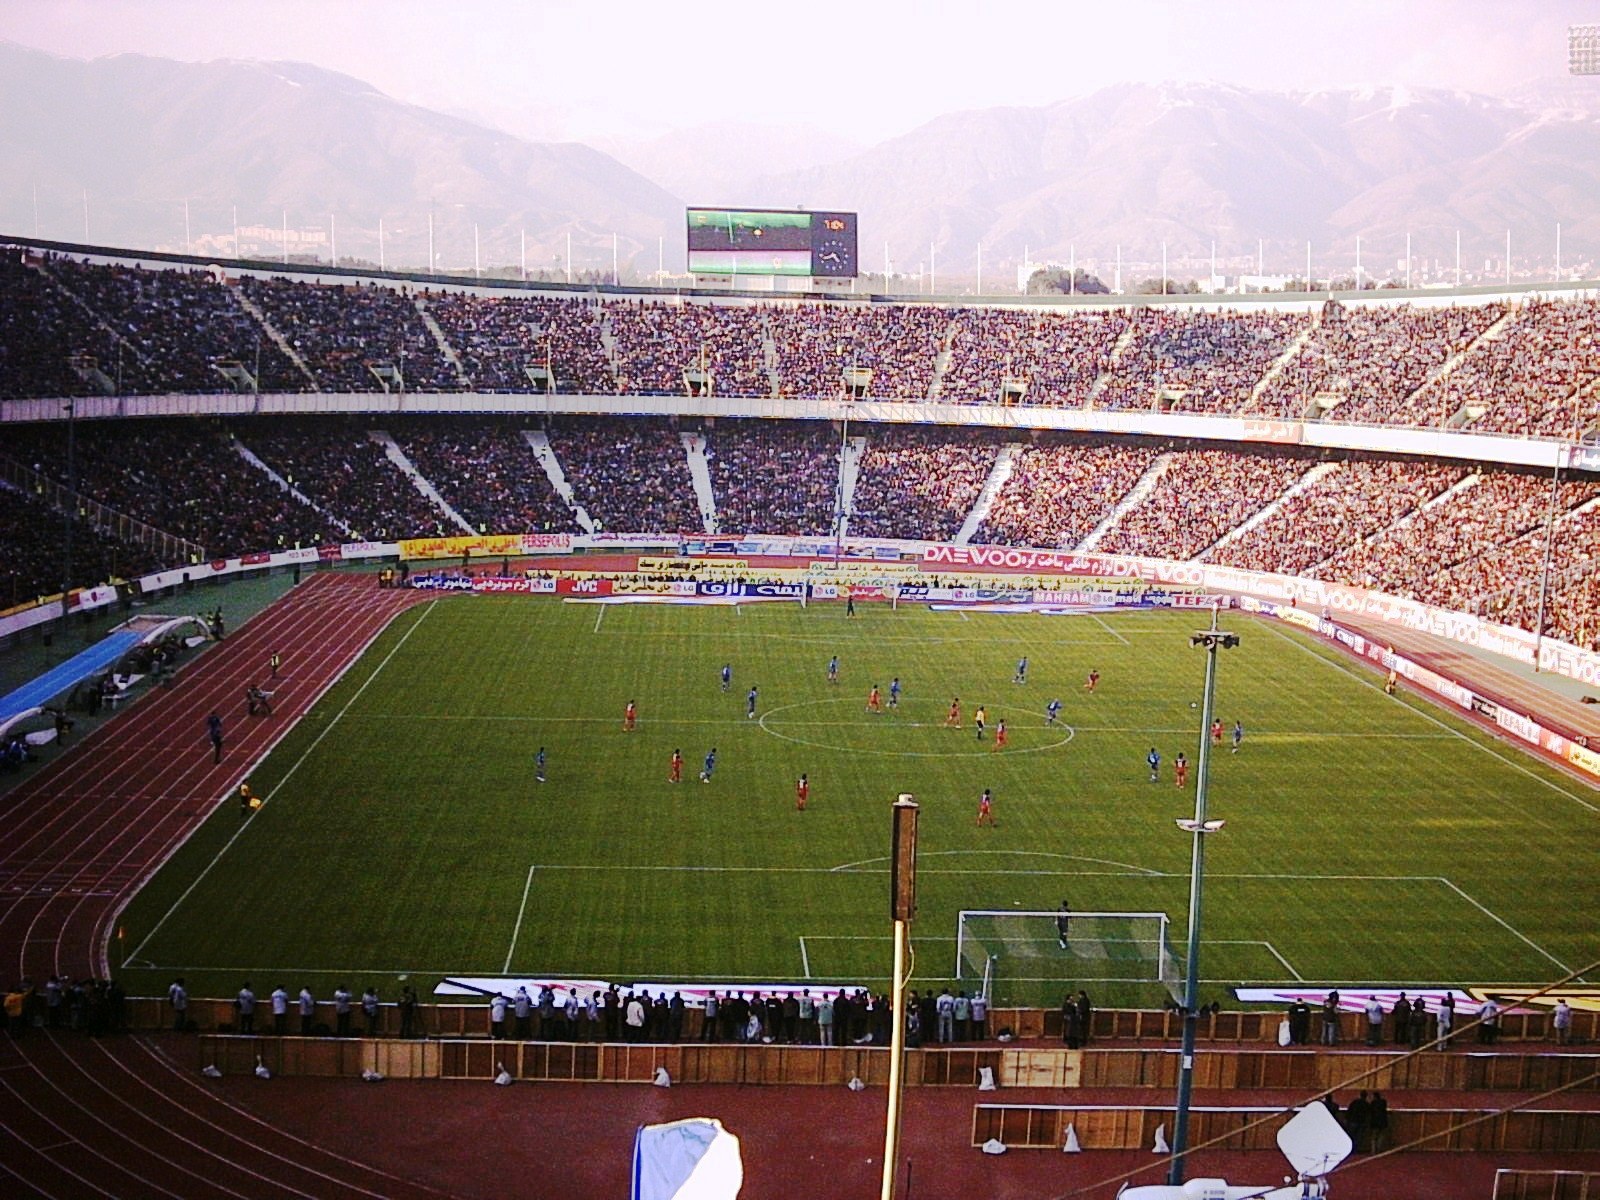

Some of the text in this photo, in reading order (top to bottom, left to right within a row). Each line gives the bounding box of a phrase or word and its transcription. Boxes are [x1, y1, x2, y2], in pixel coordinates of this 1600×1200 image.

[521, 534, 570, 548] PERSEPOLIS
[924, 545, 1021, 567] DAEWOO
[1113, 561, 1204, 585] DAEWOO
[571, 580, 598, 592] JVC
[1035, 591, 1090, 604] MAHRAM
[1173, 594, 1228, 606] TEFAL
[1285, 580, 1356, 612] DAEWOO
[1413, 607, 1480, 646] DAEWOO
